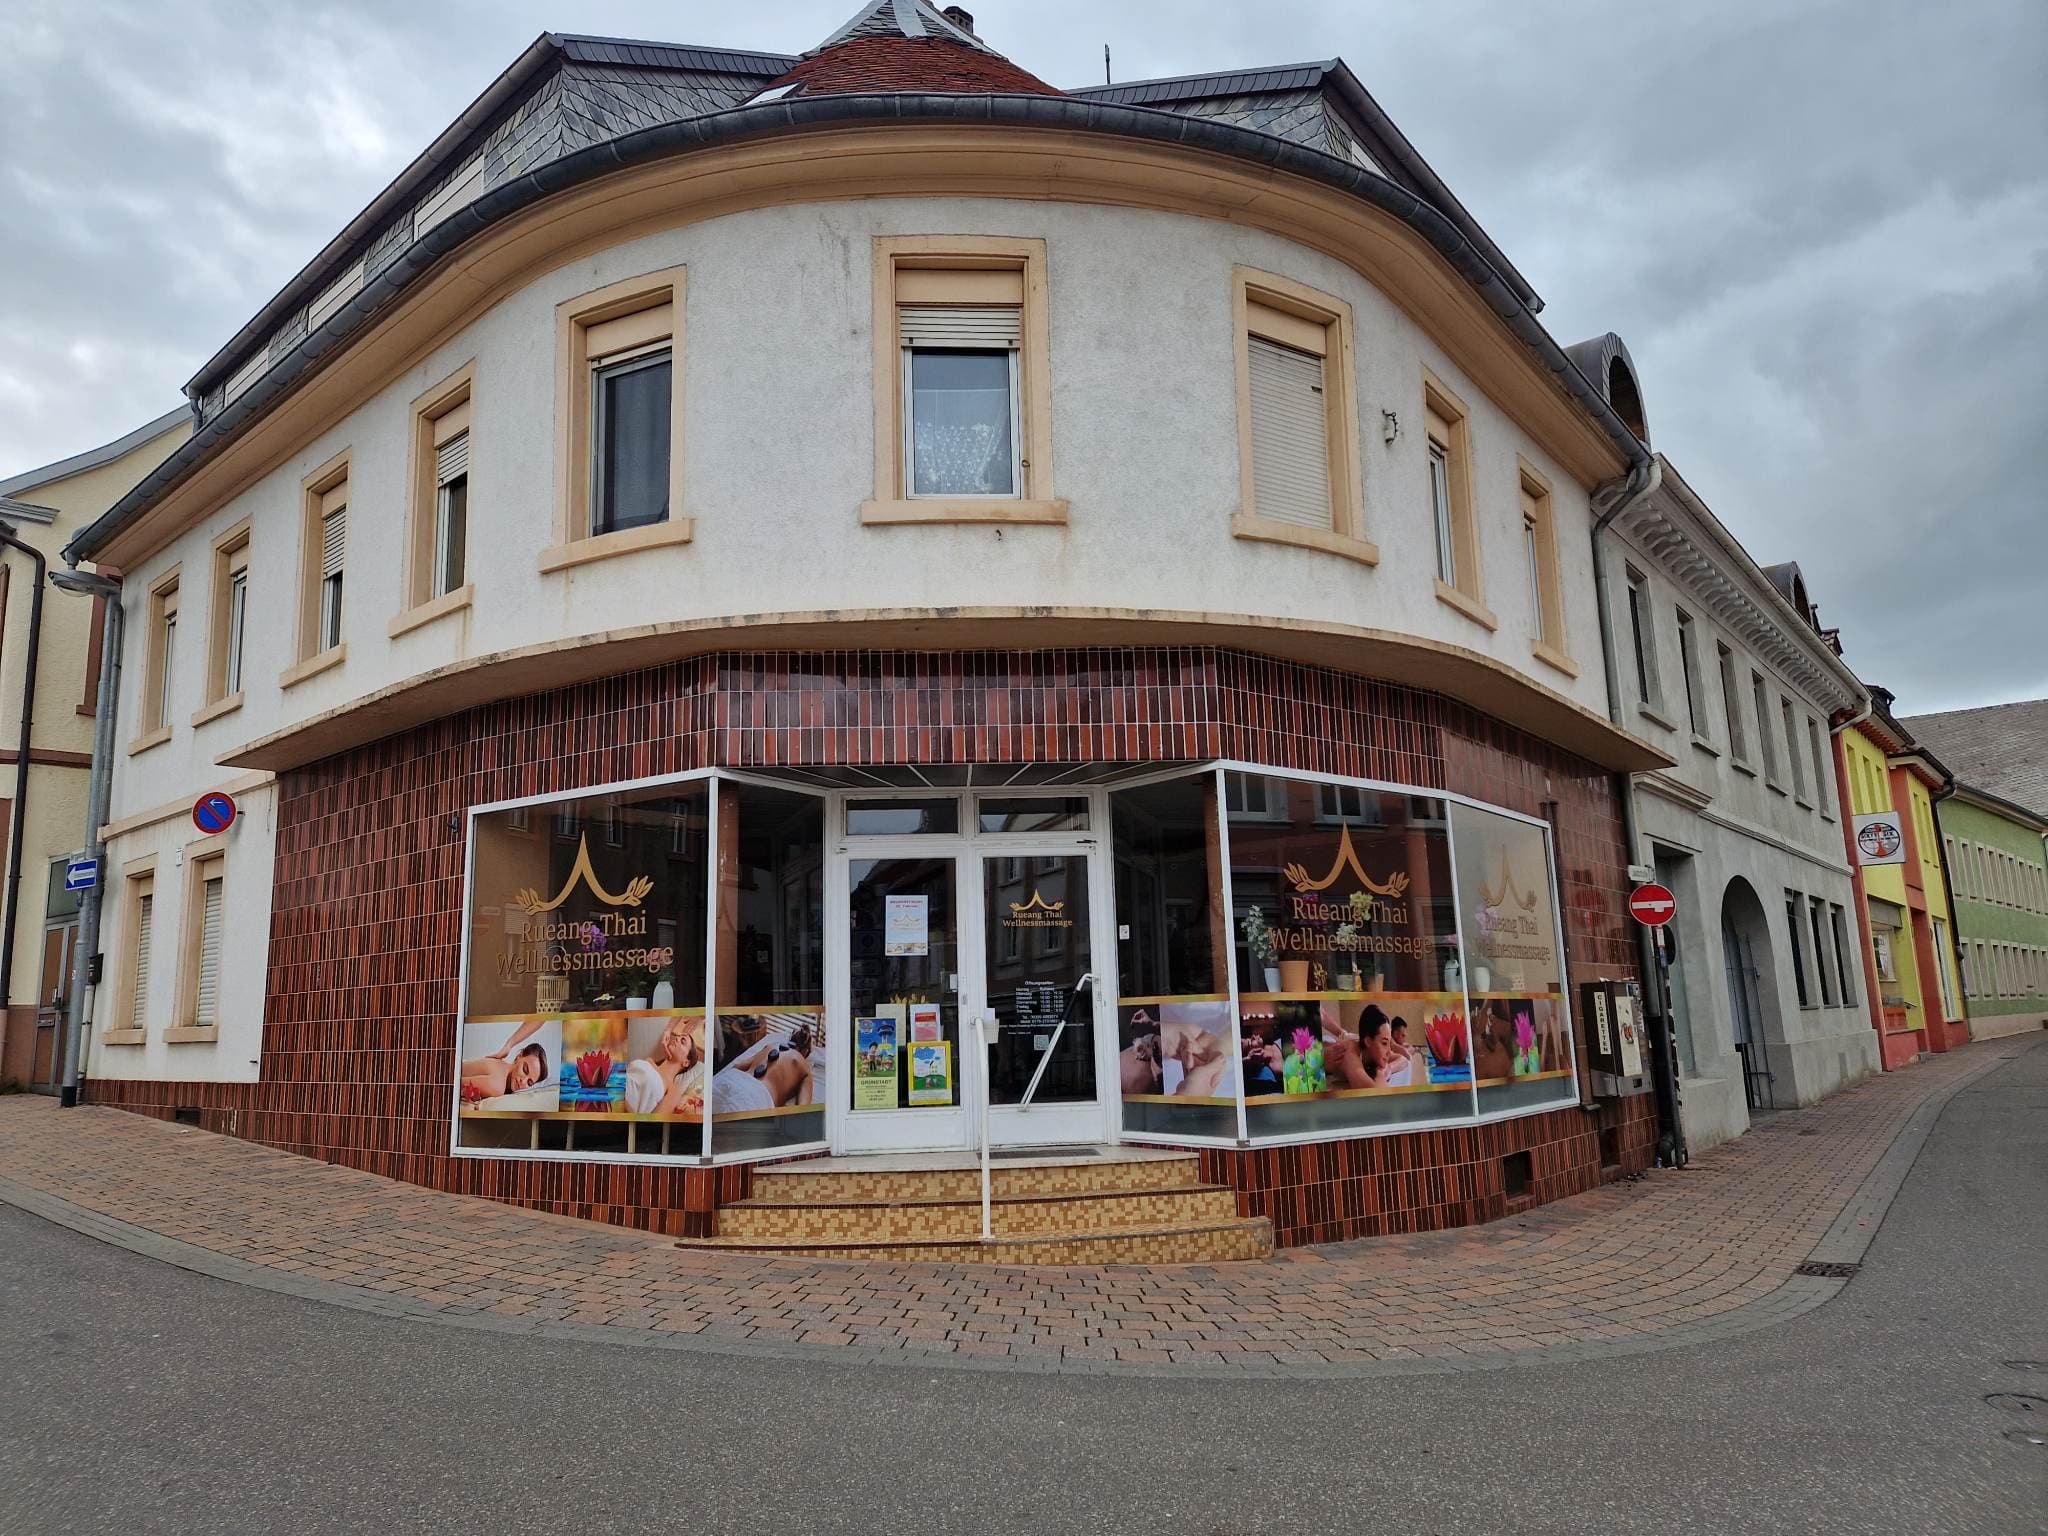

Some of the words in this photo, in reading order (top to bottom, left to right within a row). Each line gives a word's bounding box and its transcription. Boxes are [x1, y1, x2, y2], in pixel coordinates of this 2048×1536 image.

[520, 919, 594, 946] Rueang
[599, 909, 647, 938] Thai
[1002, 919, 1073, 927] Wellnessmassage
[1012, 911, 1042, 919] Rueang
[1044, 910, 1063, 918] Thai
[1291, 896, 1365, 929] Rueang
[1370, 900, 1409, 924] Thai
[1518, 916, 1539, 935] Thai
[1268, 926, 1434, 960] Wellnessmassage
[496, 945, 674, 977] Wellnessmassage
